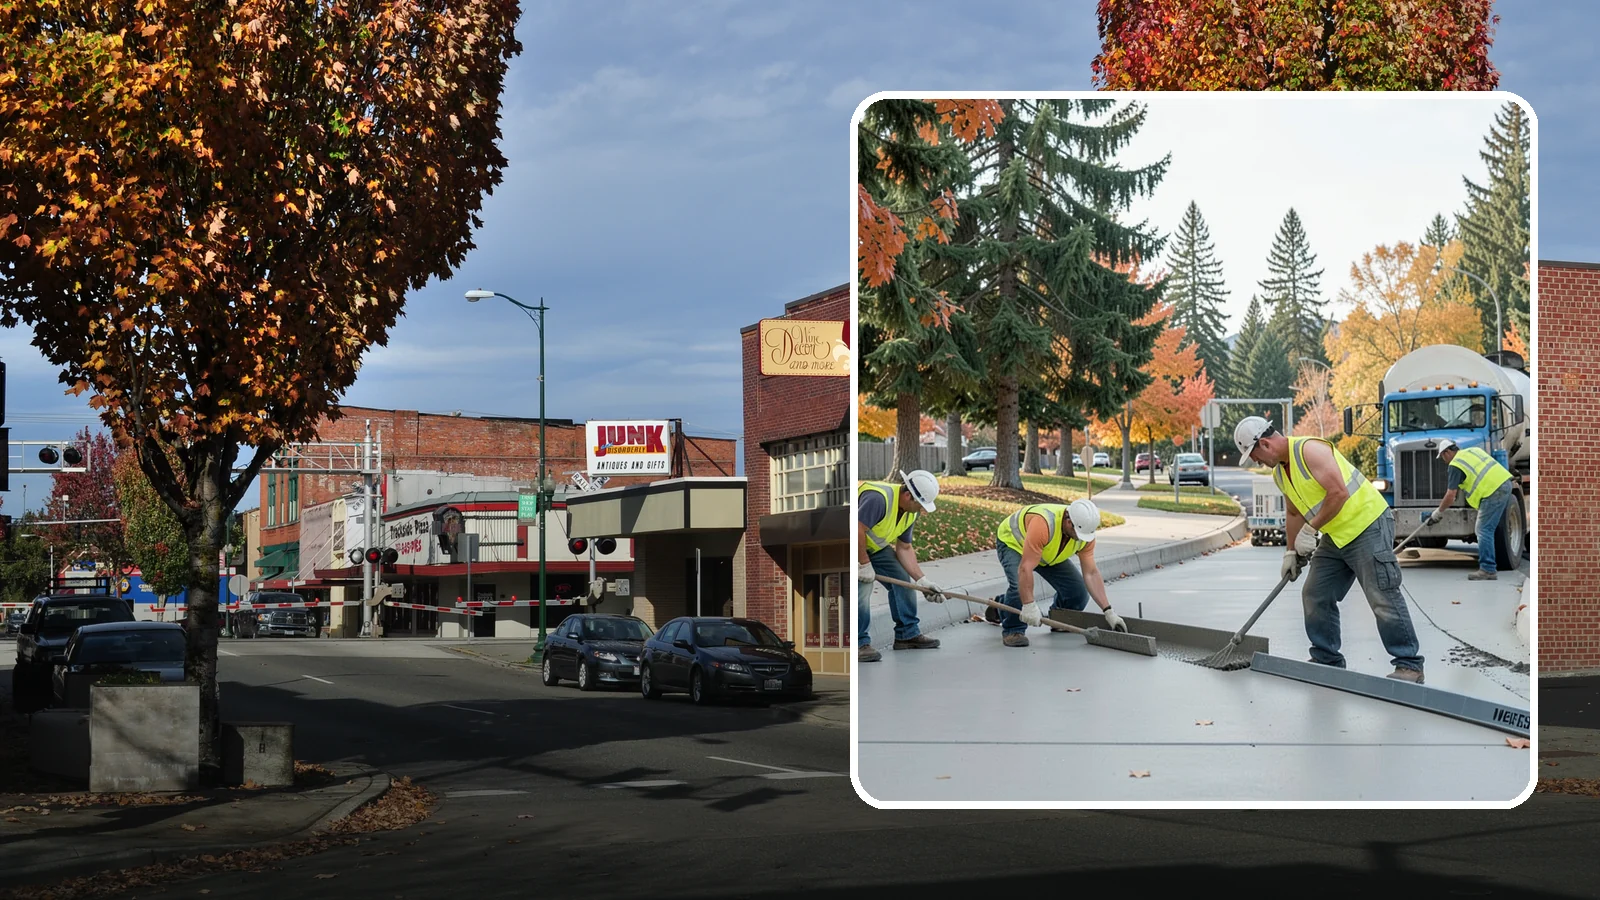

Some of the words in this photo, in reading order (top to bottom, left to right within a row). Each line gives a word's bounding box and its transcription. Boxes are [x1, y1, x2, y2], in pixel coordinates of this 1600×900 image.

[764, 328, 831, 365] Decor
[595, 425, 665, 457] JUNK
[607, 446, 645, 454] DISORDERLY
[597, 461, 628, 470] ANTIQUES
[631, 461, 644, 470] AND
[647, 460, 666, 470] GIFTS
[390, 521, 413, 539] Trackside
[415, 519, 429, 535] Pizza
